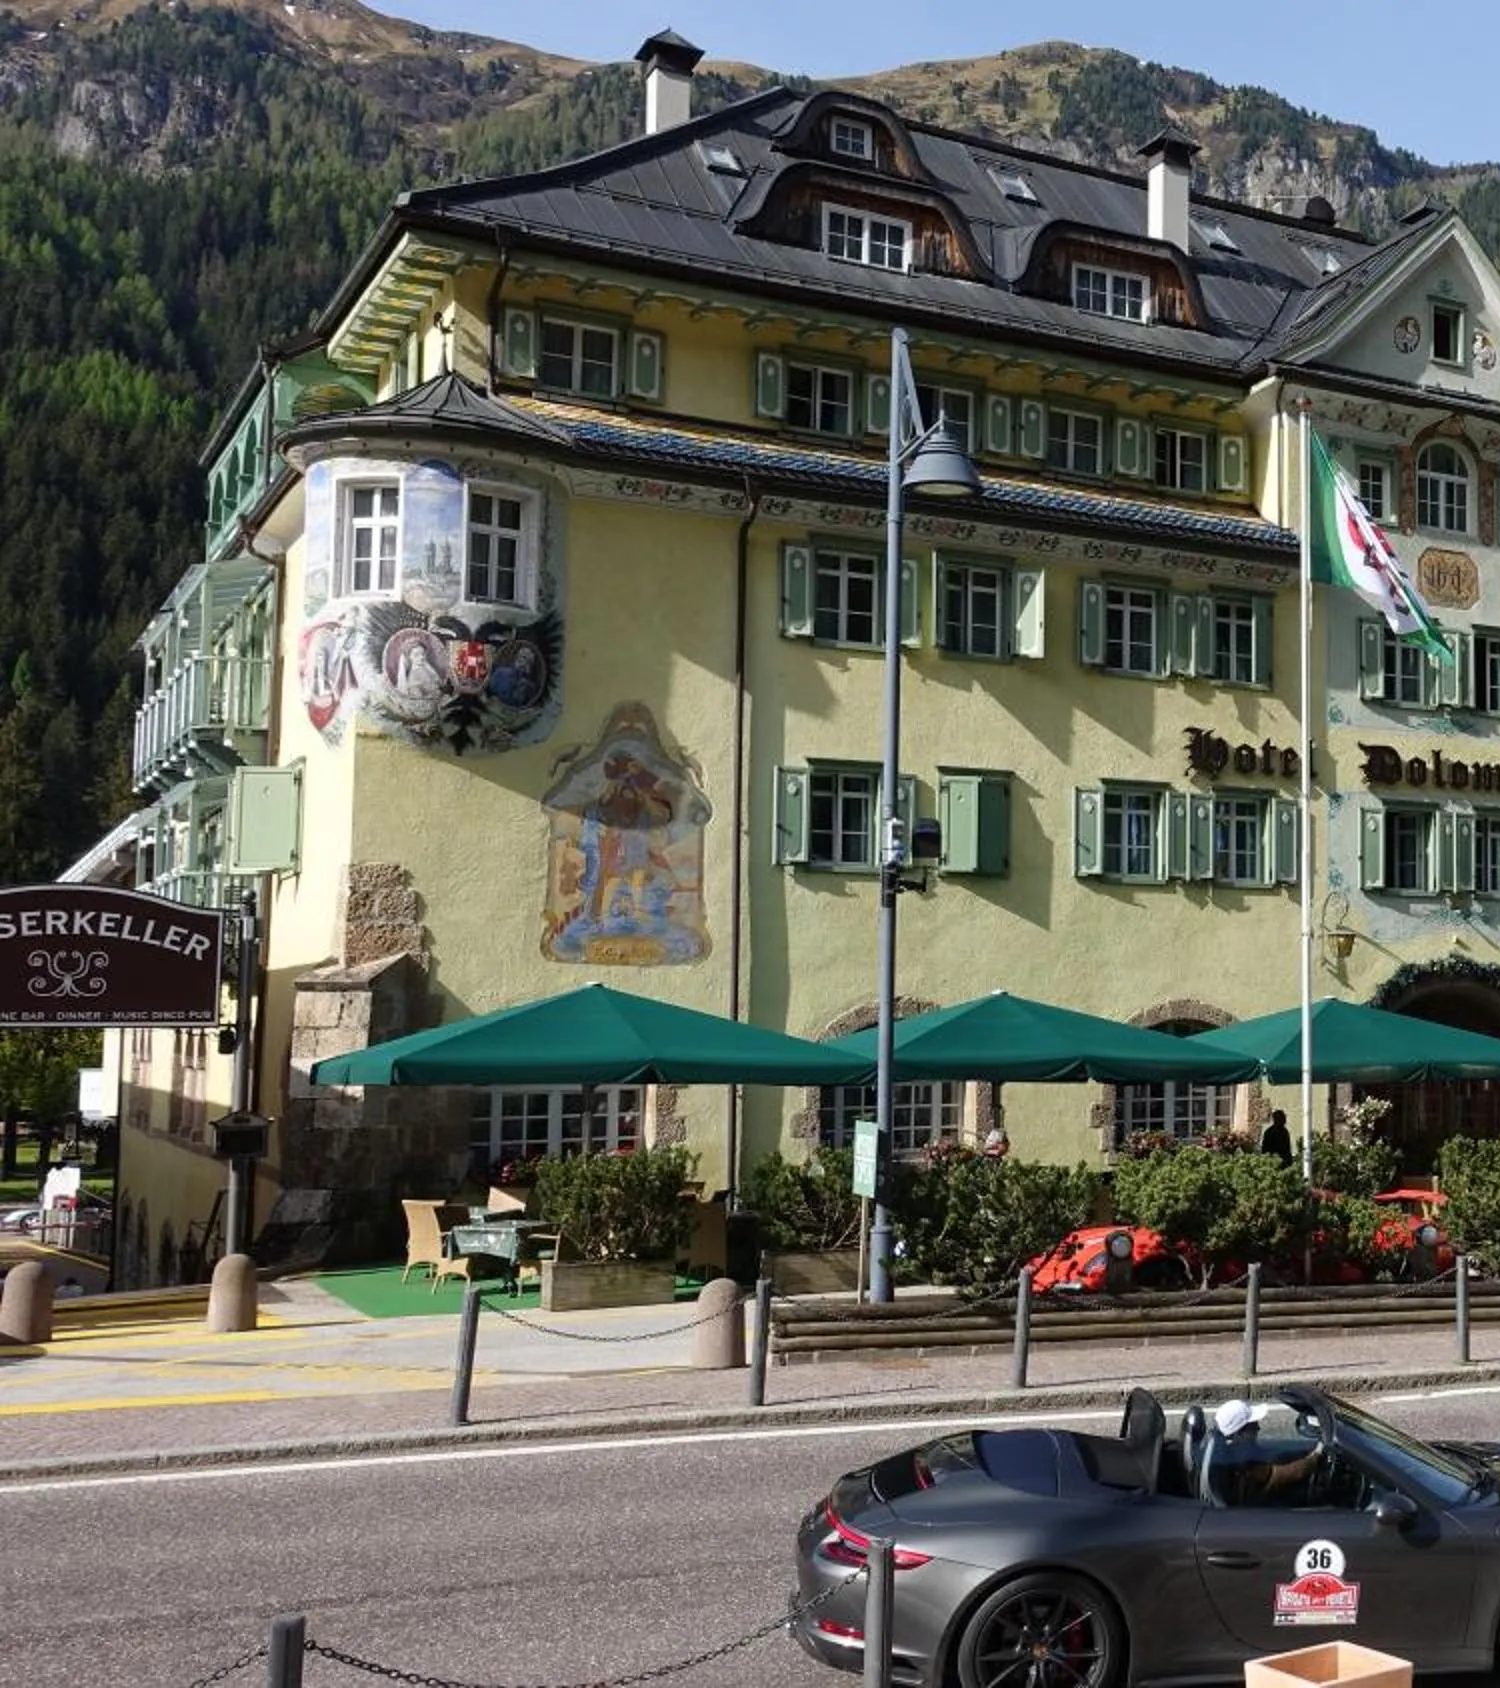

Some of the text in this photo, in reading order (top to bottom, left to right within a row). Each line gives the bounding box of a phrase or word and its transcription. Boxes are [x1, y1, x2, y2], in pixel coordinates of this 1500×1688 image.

[1183, 726, 1319, 780] Hotel
[21, 1011, 45, 1021] BAR
[56, 1011, 101, 1021] DINNER
[112, 1011, 149, 1020] MUSIC
[1307, 1547, 1332, 1569] 36
